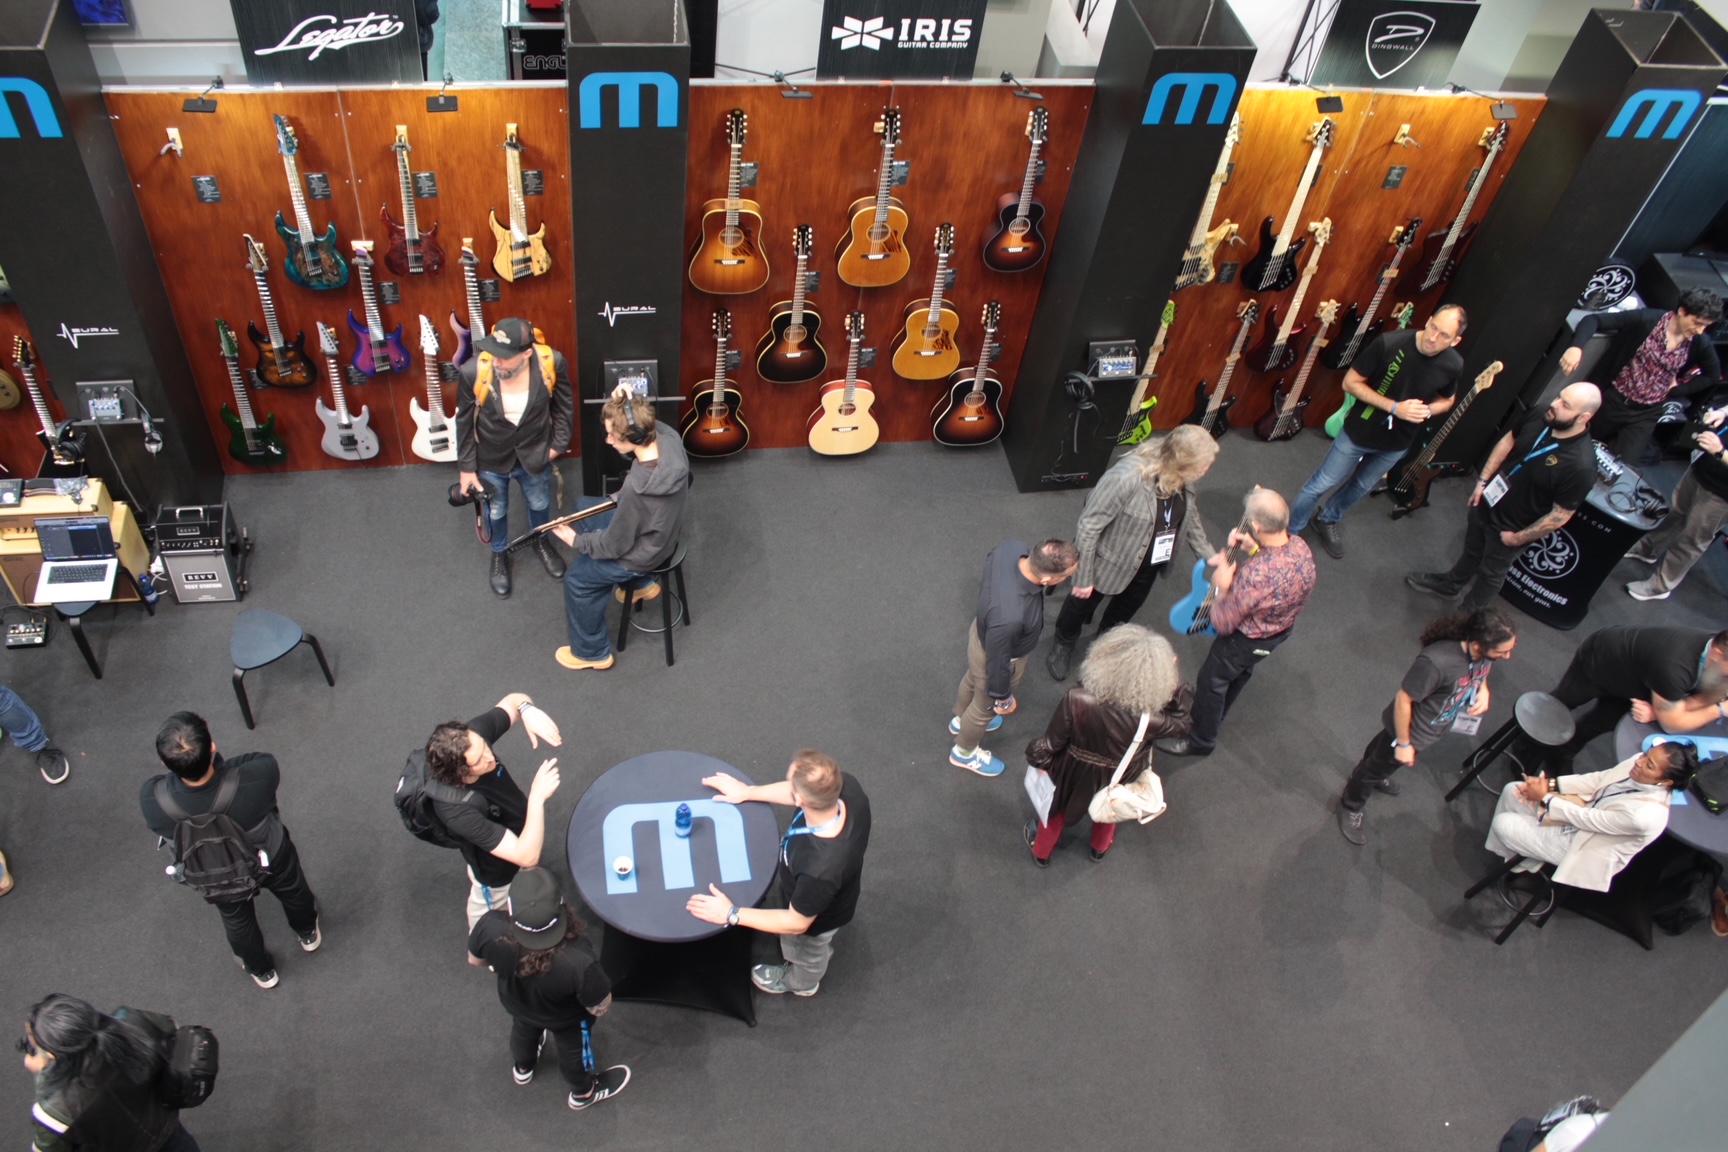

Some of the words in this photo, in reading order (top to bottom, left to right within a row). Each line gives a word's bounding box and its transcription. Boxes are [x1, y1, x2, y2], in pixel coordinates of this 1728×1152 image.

[254, 12, 404, 61] Legator
[898, 18, 973, 41] IRIS
[897, 41, 927, 49] GUITAR
[929, 41, 968, 49] COMPANY
[1371, 43, 1415, 51] DINGWALL
[1520, 574, 1568, 606] Electronics
